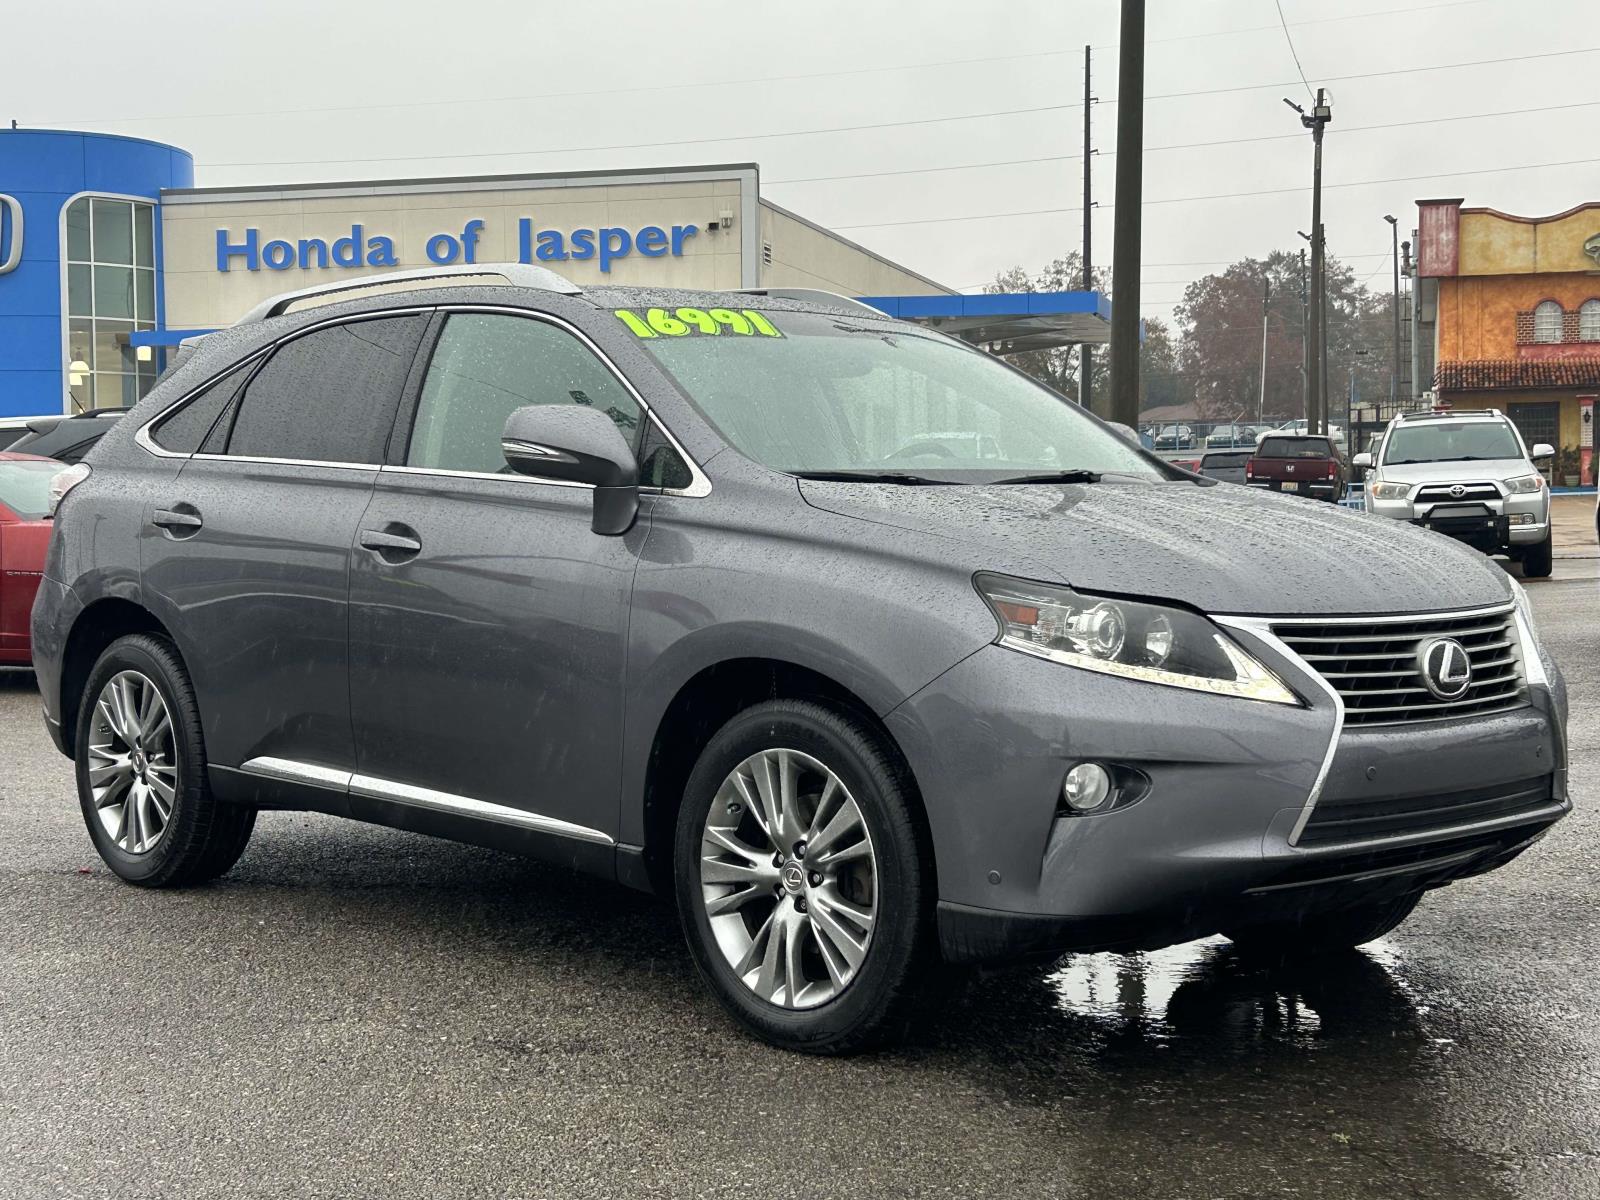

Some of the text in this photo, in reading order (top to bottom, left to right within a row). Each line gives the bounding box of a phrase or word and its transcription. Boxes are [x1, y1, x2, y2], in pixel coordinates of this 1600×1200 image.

[216, 218, 698, 273] Honda of Jasper
[614, 308, 781, 338] 16991
